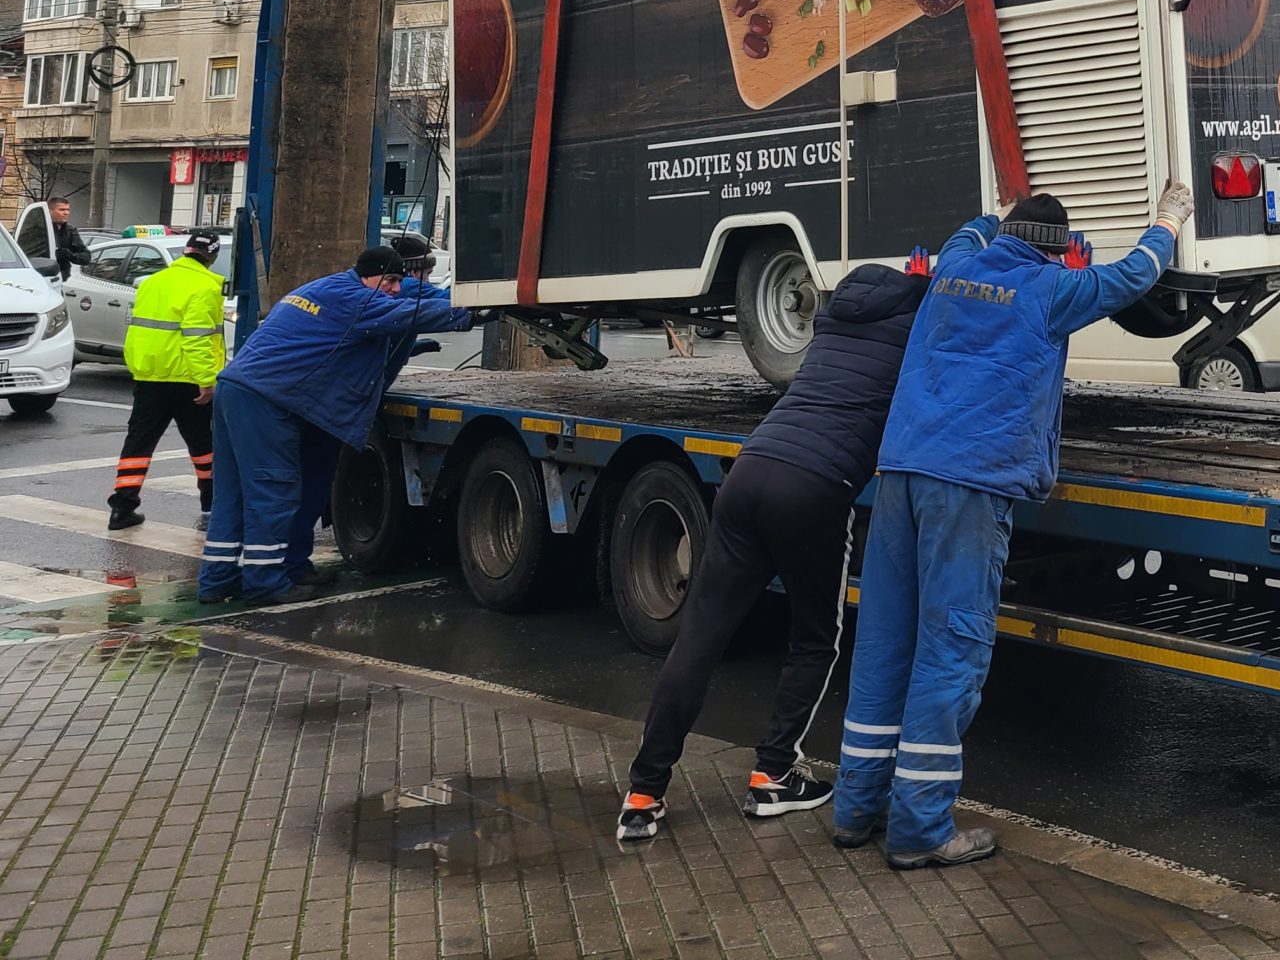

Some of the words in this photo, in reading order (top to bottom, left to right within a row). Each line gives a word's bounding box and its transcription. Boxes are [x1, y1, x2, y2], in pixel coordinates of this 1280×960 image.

[647, 153, 732, 183] TRADIȚIE
[735, 149, 753, 179] ȘI
[757, 146, 797, 170] BUN
[802, 139, 855, 166] GUST
[720, 184, 742, 200] din
[745, 180, 772, 197] 1992
